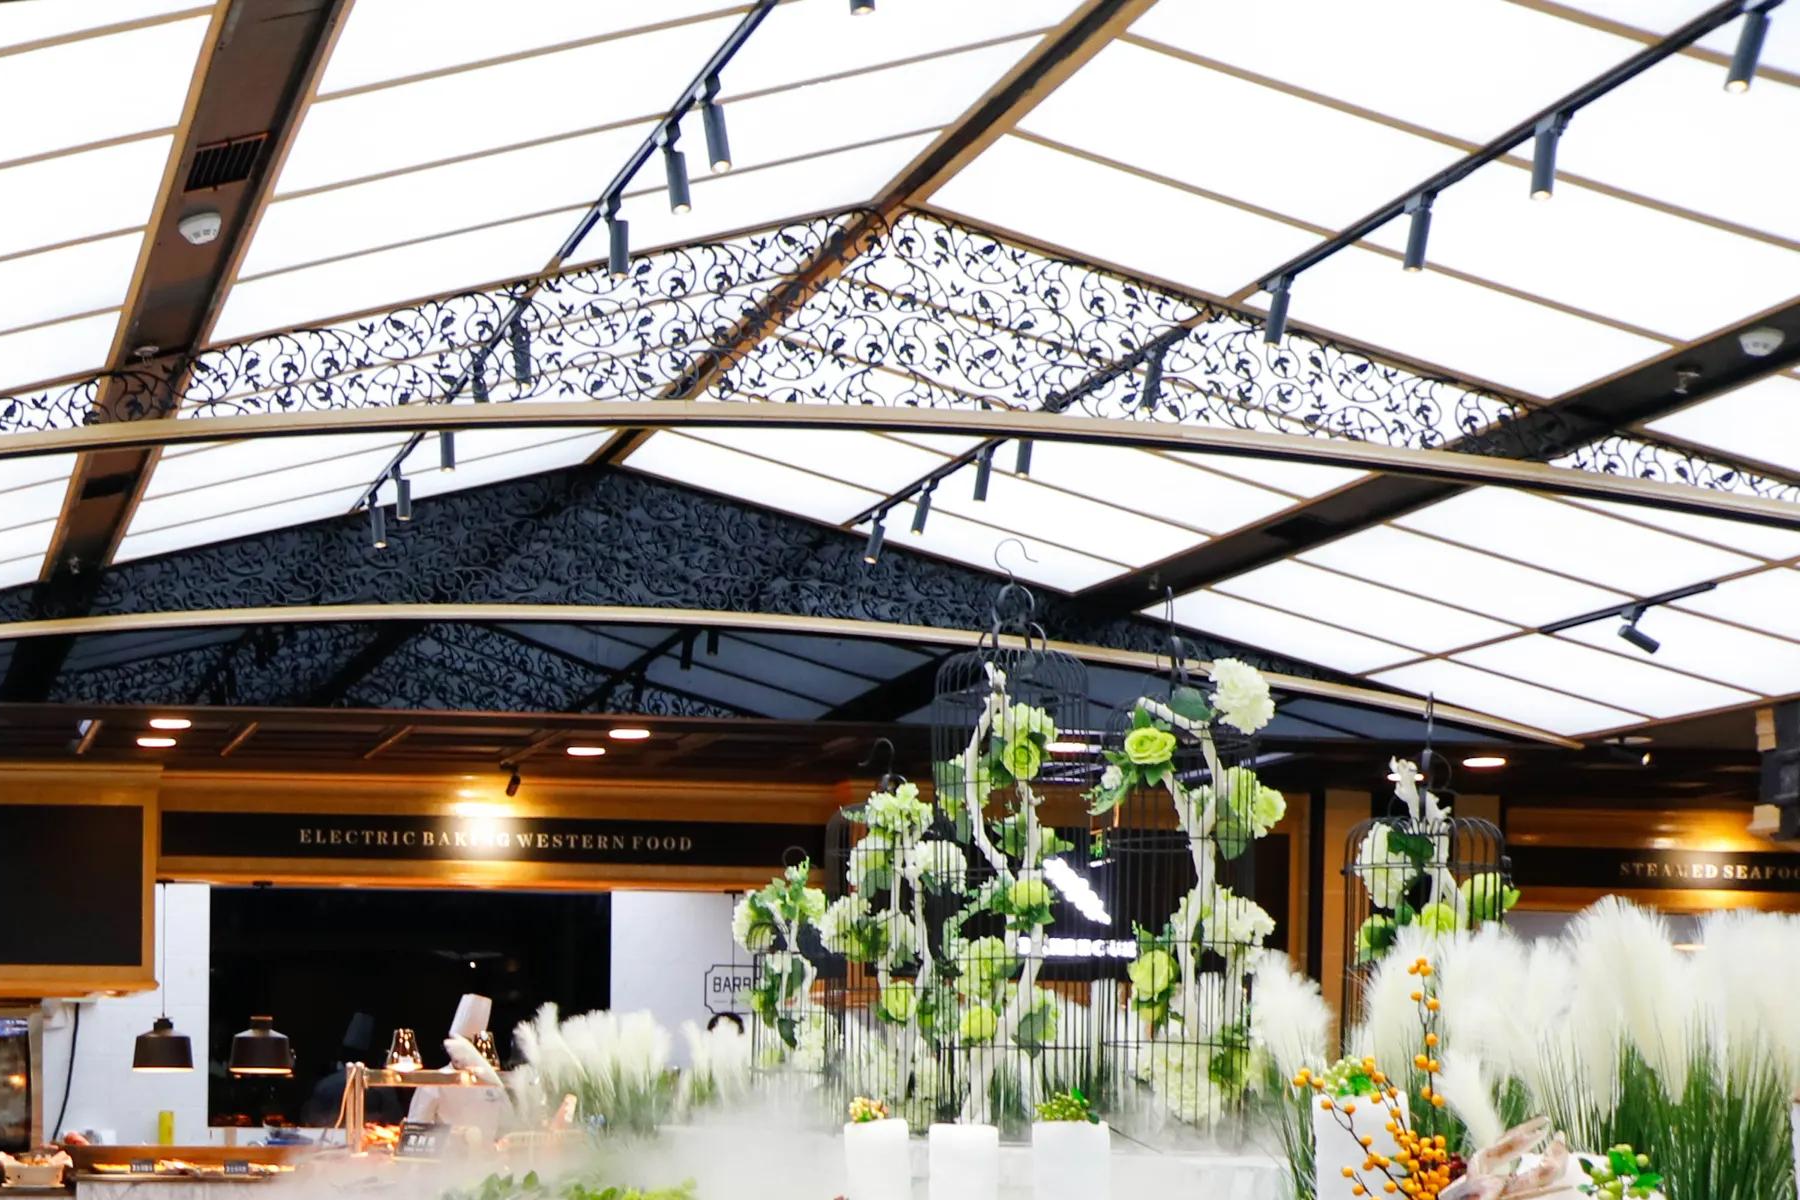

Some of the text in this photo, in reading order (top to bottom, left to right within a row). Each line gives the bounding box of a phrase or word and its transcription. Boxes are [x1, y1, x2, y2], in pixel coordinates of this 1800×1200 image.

[299, 828, 693, 852] ELECTRIC BAKG WESTERN FOOD
[1619, 862, 1718, 879] STEAMED
